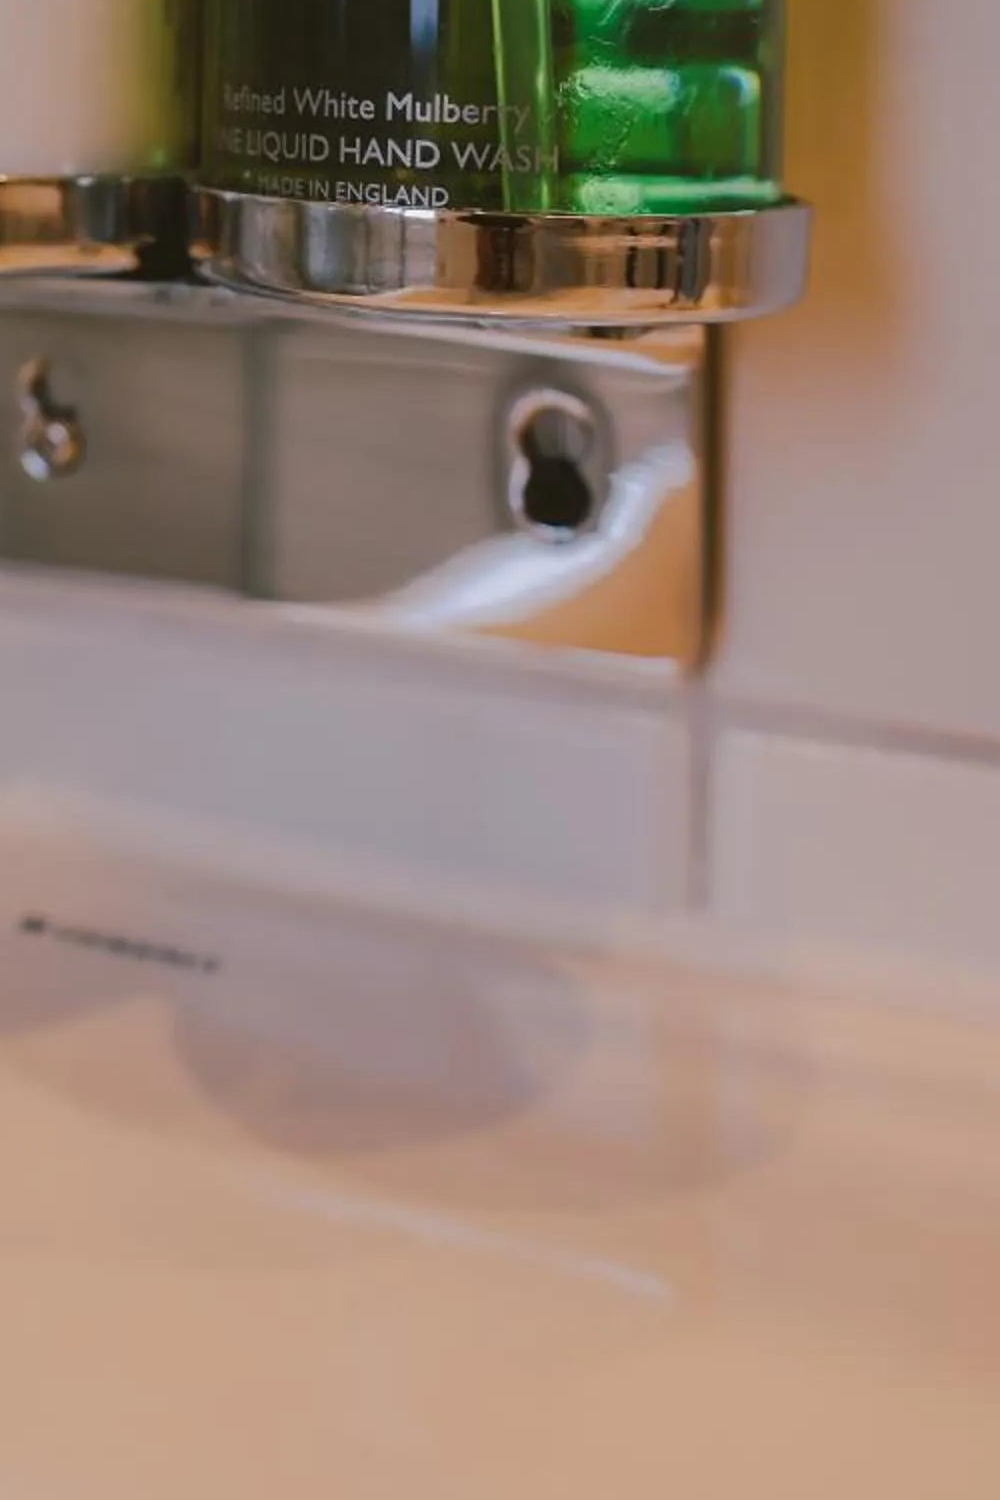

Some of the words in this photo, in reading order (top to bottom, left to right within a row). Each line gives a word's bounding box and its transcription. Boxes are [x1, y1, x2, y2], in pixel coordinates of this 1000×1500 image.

[293, 86, 375, 120] White
[386, 90, 531, 134] Mulberry
[246, 131, 330, 162] LIQUID
[339, 136, 441, 170] HAND
[451, 141, 559, 174] WASH
[309, 179, 330, 198] IN
[335, 181, 449, 208] ENGLAND
